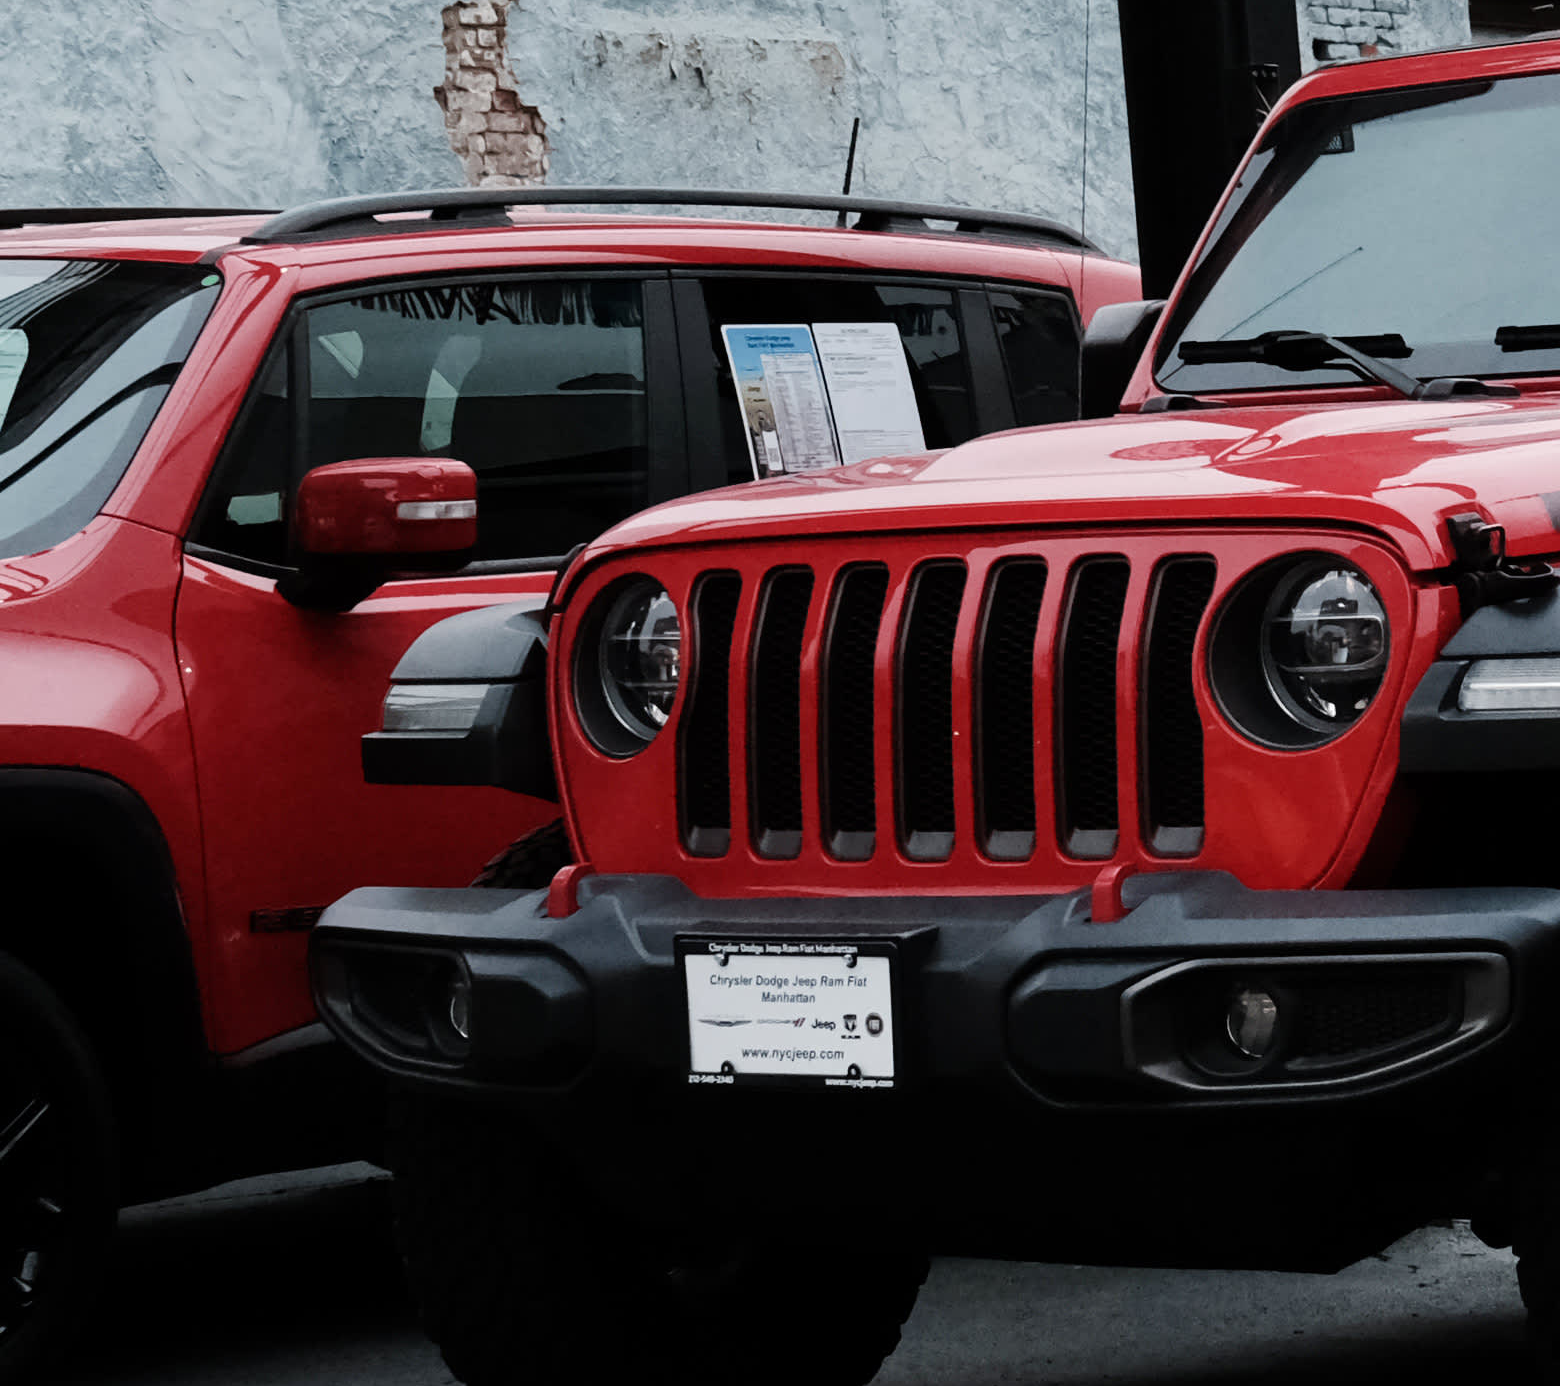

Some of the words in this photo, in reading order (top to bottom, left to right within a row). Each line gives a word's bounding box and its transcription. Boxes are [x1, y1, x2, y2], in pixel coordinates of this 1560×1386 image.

[709, 974, 753, 988] Chrysler
[755, 975, 790, 988] Dodge
[791, 975, 818, 988] Jeep
[820, 975, 844, 987] Ram
[847, 975, 868, 987] Fiat
[761, 991, 816, 1004] Manhattan
[741, 1046, 845, 1062] www.nycjeep.com
